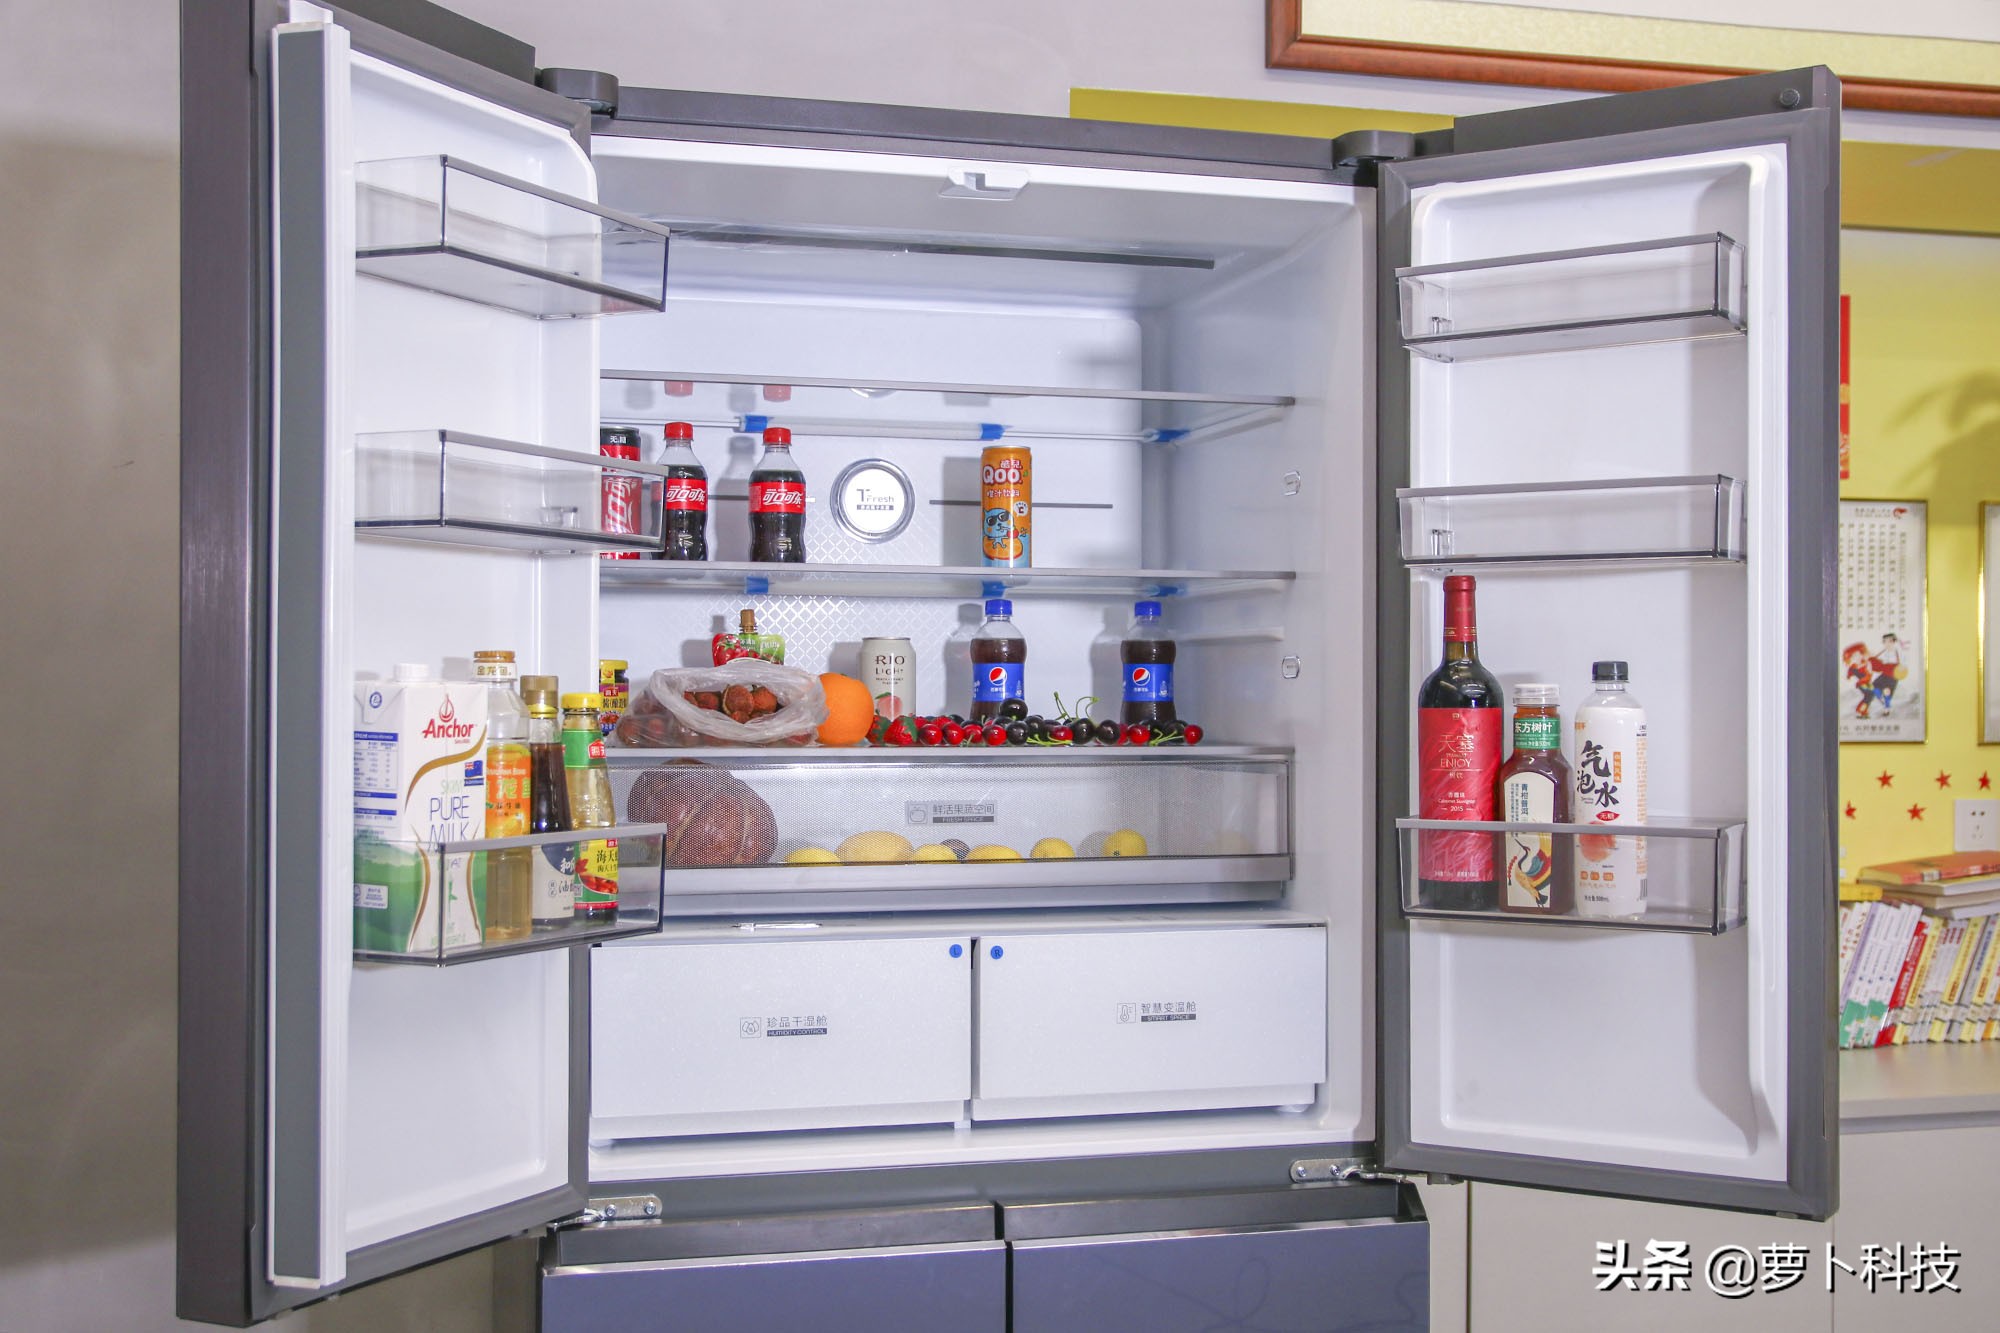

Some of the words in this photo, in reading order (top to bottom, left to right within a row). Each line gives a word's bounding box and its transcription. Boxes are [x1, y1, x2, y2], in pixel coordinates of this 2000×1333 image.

[666, 487, 706, 503] 可口可乐
[763, 490, 802, 506] 可口可乐
[875, 655, 905, 665] RIO
[422, 718, 474, 738] Anchor
[1515, 721, 1553, 733] 东方树叶
[1440, 758, 1472, 769] ENJOY
[1577, 740, 1619, 807] 气泡水
[430, 795, 470, 821] PURE
[427, 821, 470, 852] MILK
